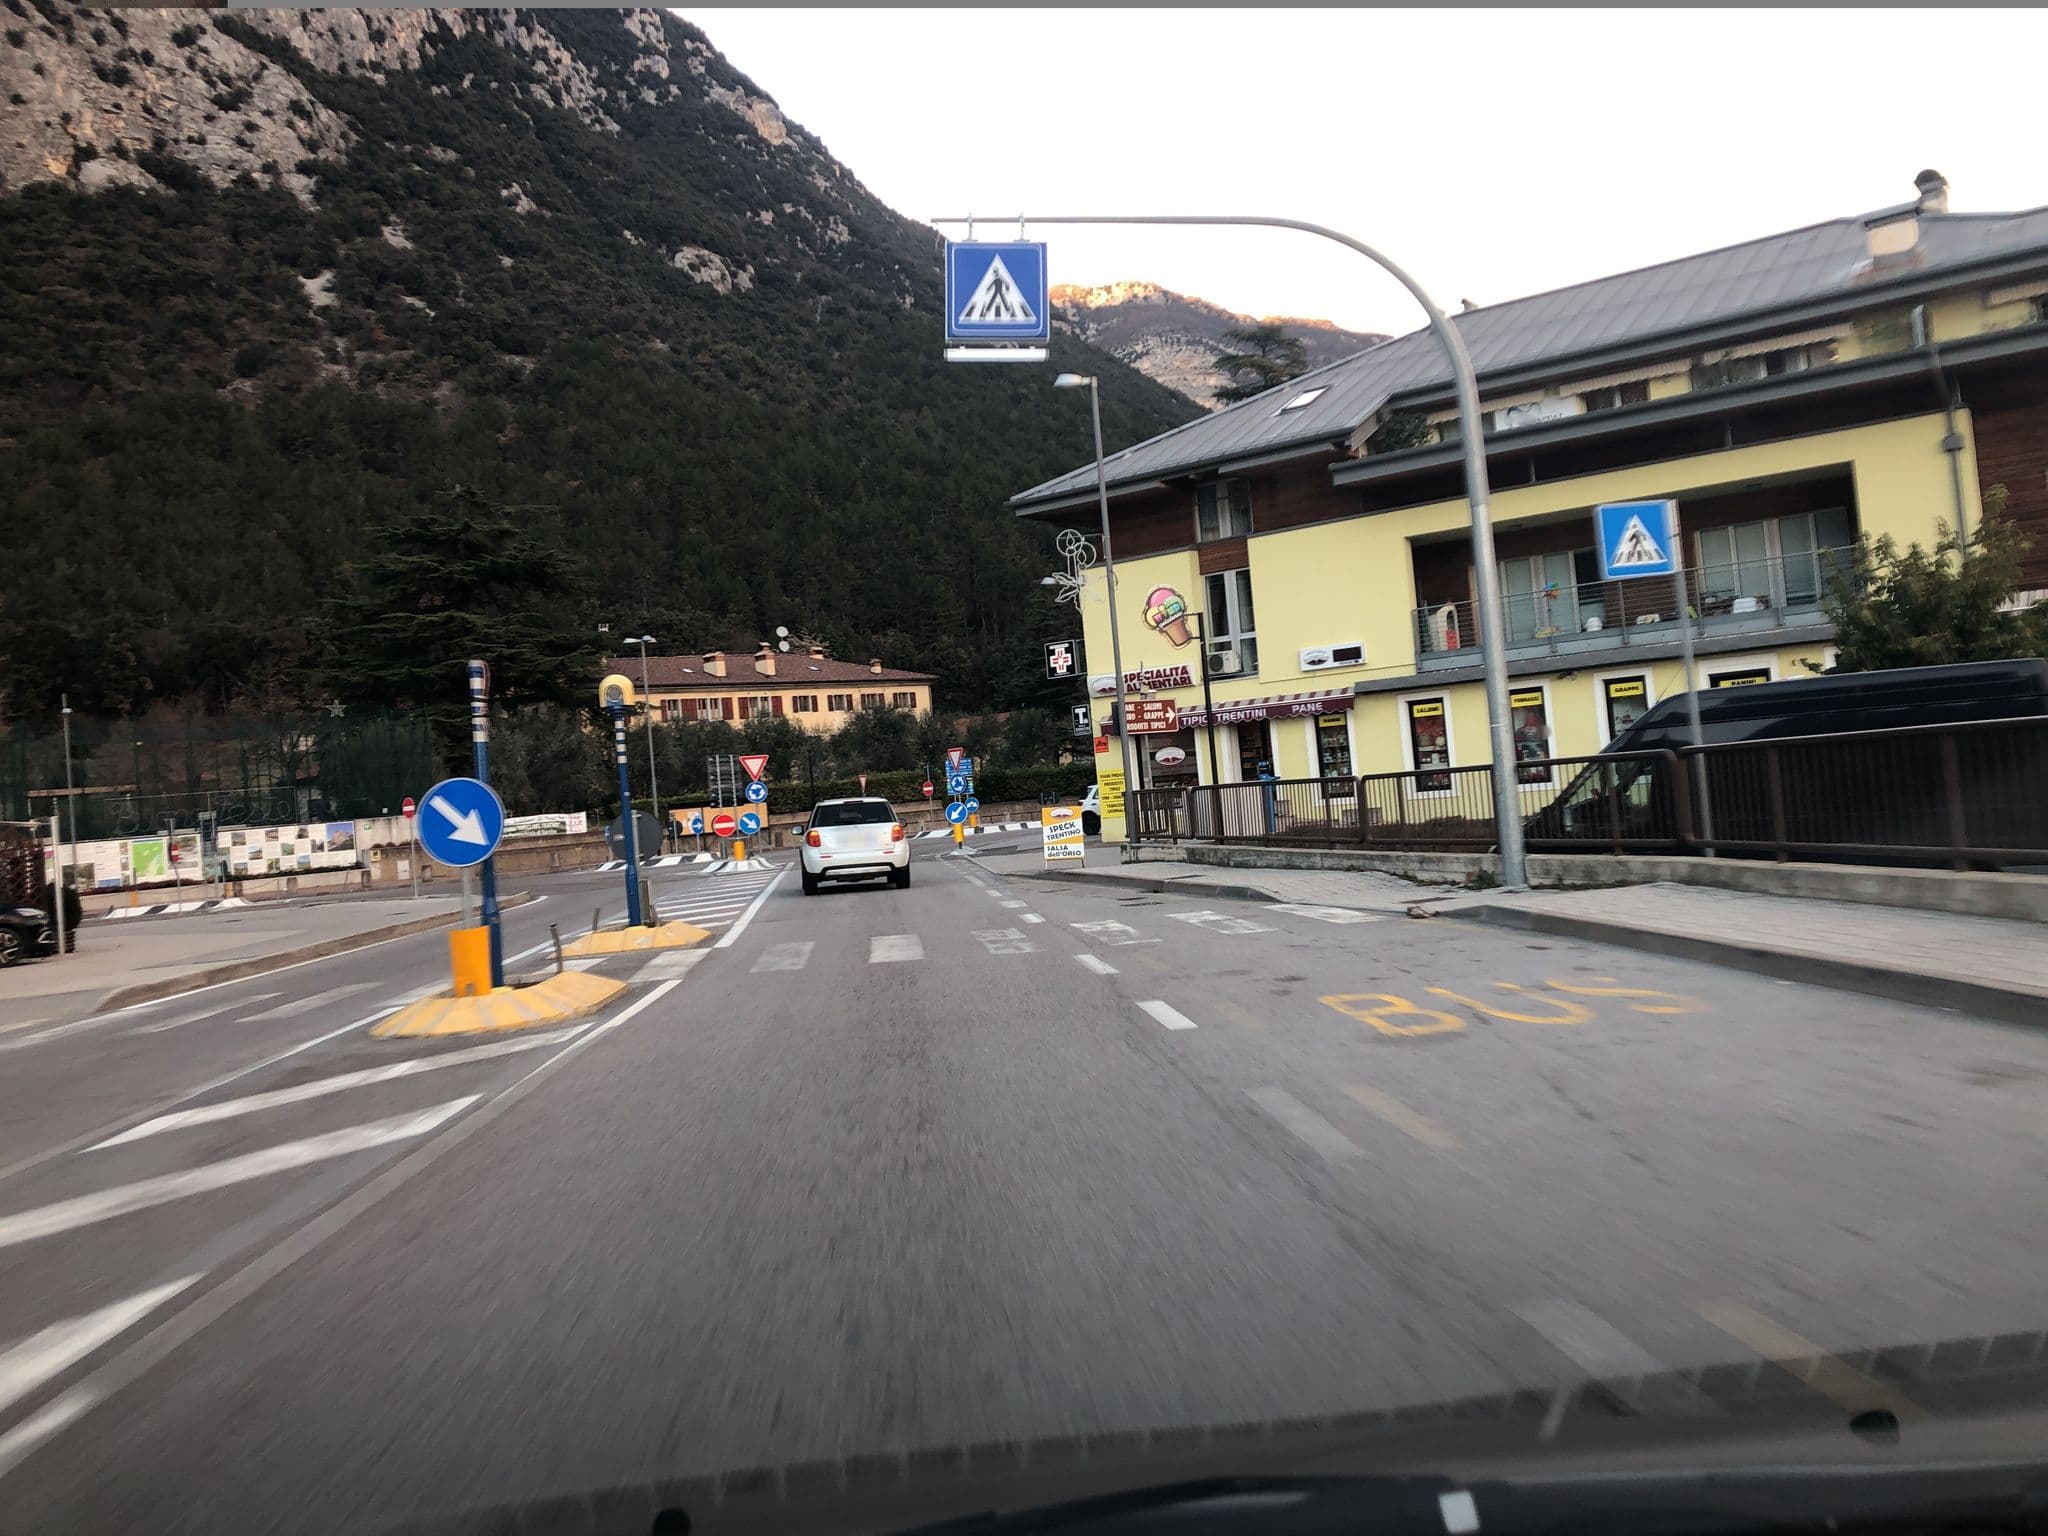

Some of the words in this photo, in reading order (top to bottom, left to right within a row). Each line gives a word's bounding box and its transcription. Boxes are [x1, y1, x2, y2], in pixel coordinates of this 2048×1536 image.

[1292, 702, 1323, 713] PANE
[1144, 711, 1165, 719] GRAPPE
[1181, 715, 1209, 726] TIPIC
[1216, 708, 1267, 722] TRENTINI
[1126, 722, 1149, 730] RODOTTI
[1151, 721, 1166, 729] TIPICI
[1049, 822, 1076, 833] SPECK
[1046, 828, 1081, 841] TRENTINO
[1319, 976, 1709, 1037] BUS
